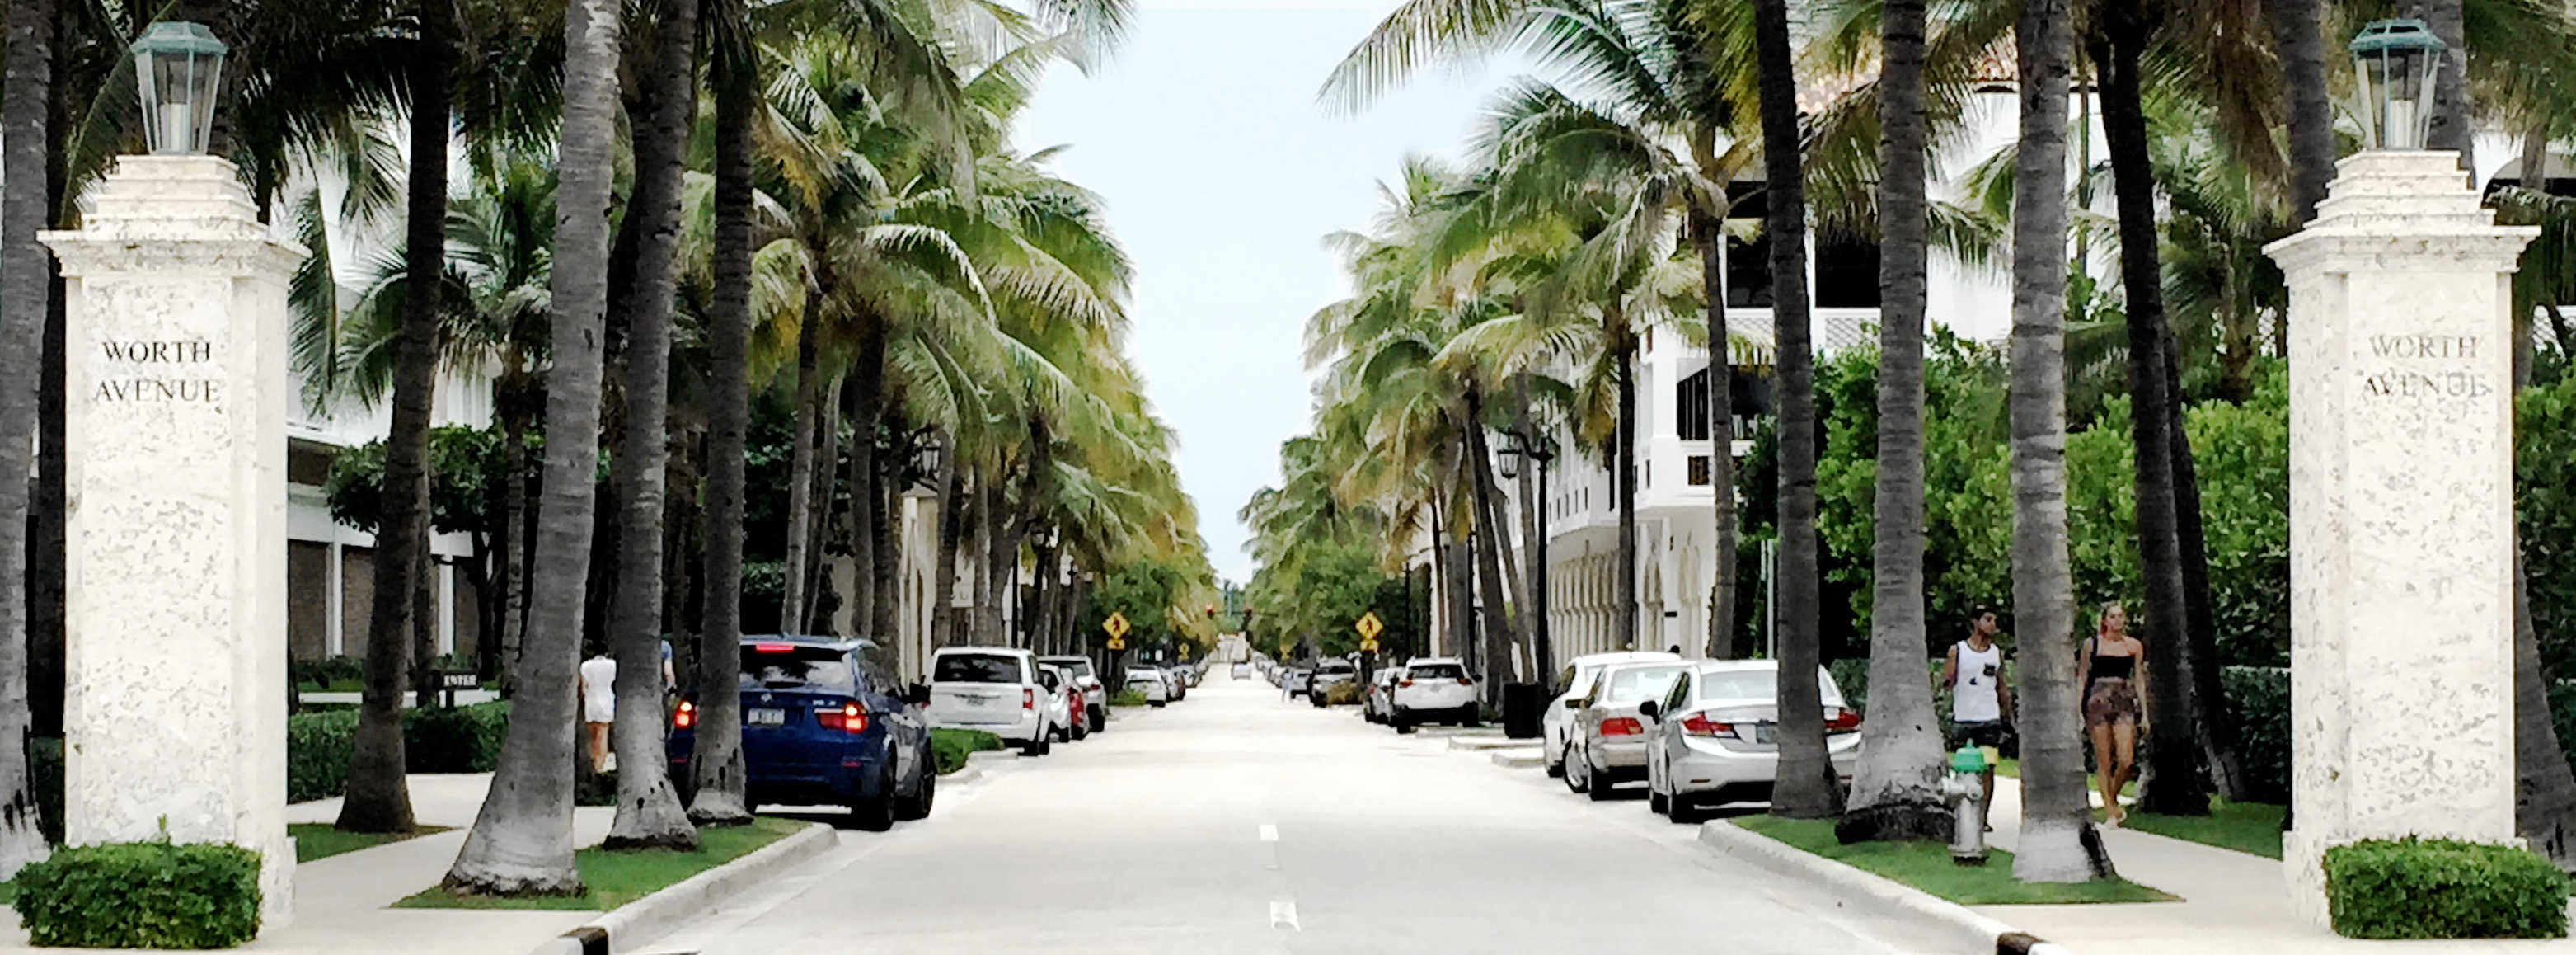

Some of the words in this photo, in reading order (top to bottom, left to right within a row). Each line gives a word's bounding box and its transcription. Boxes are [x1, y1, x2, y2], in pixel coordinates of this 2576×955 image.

[101, 339, 211, 363] WORTH
[2369, 335, 2477, 358] WORTH
[92, 379, 222, 402] AVENUE
[2363, 372, 2491, 398] AVENUE
